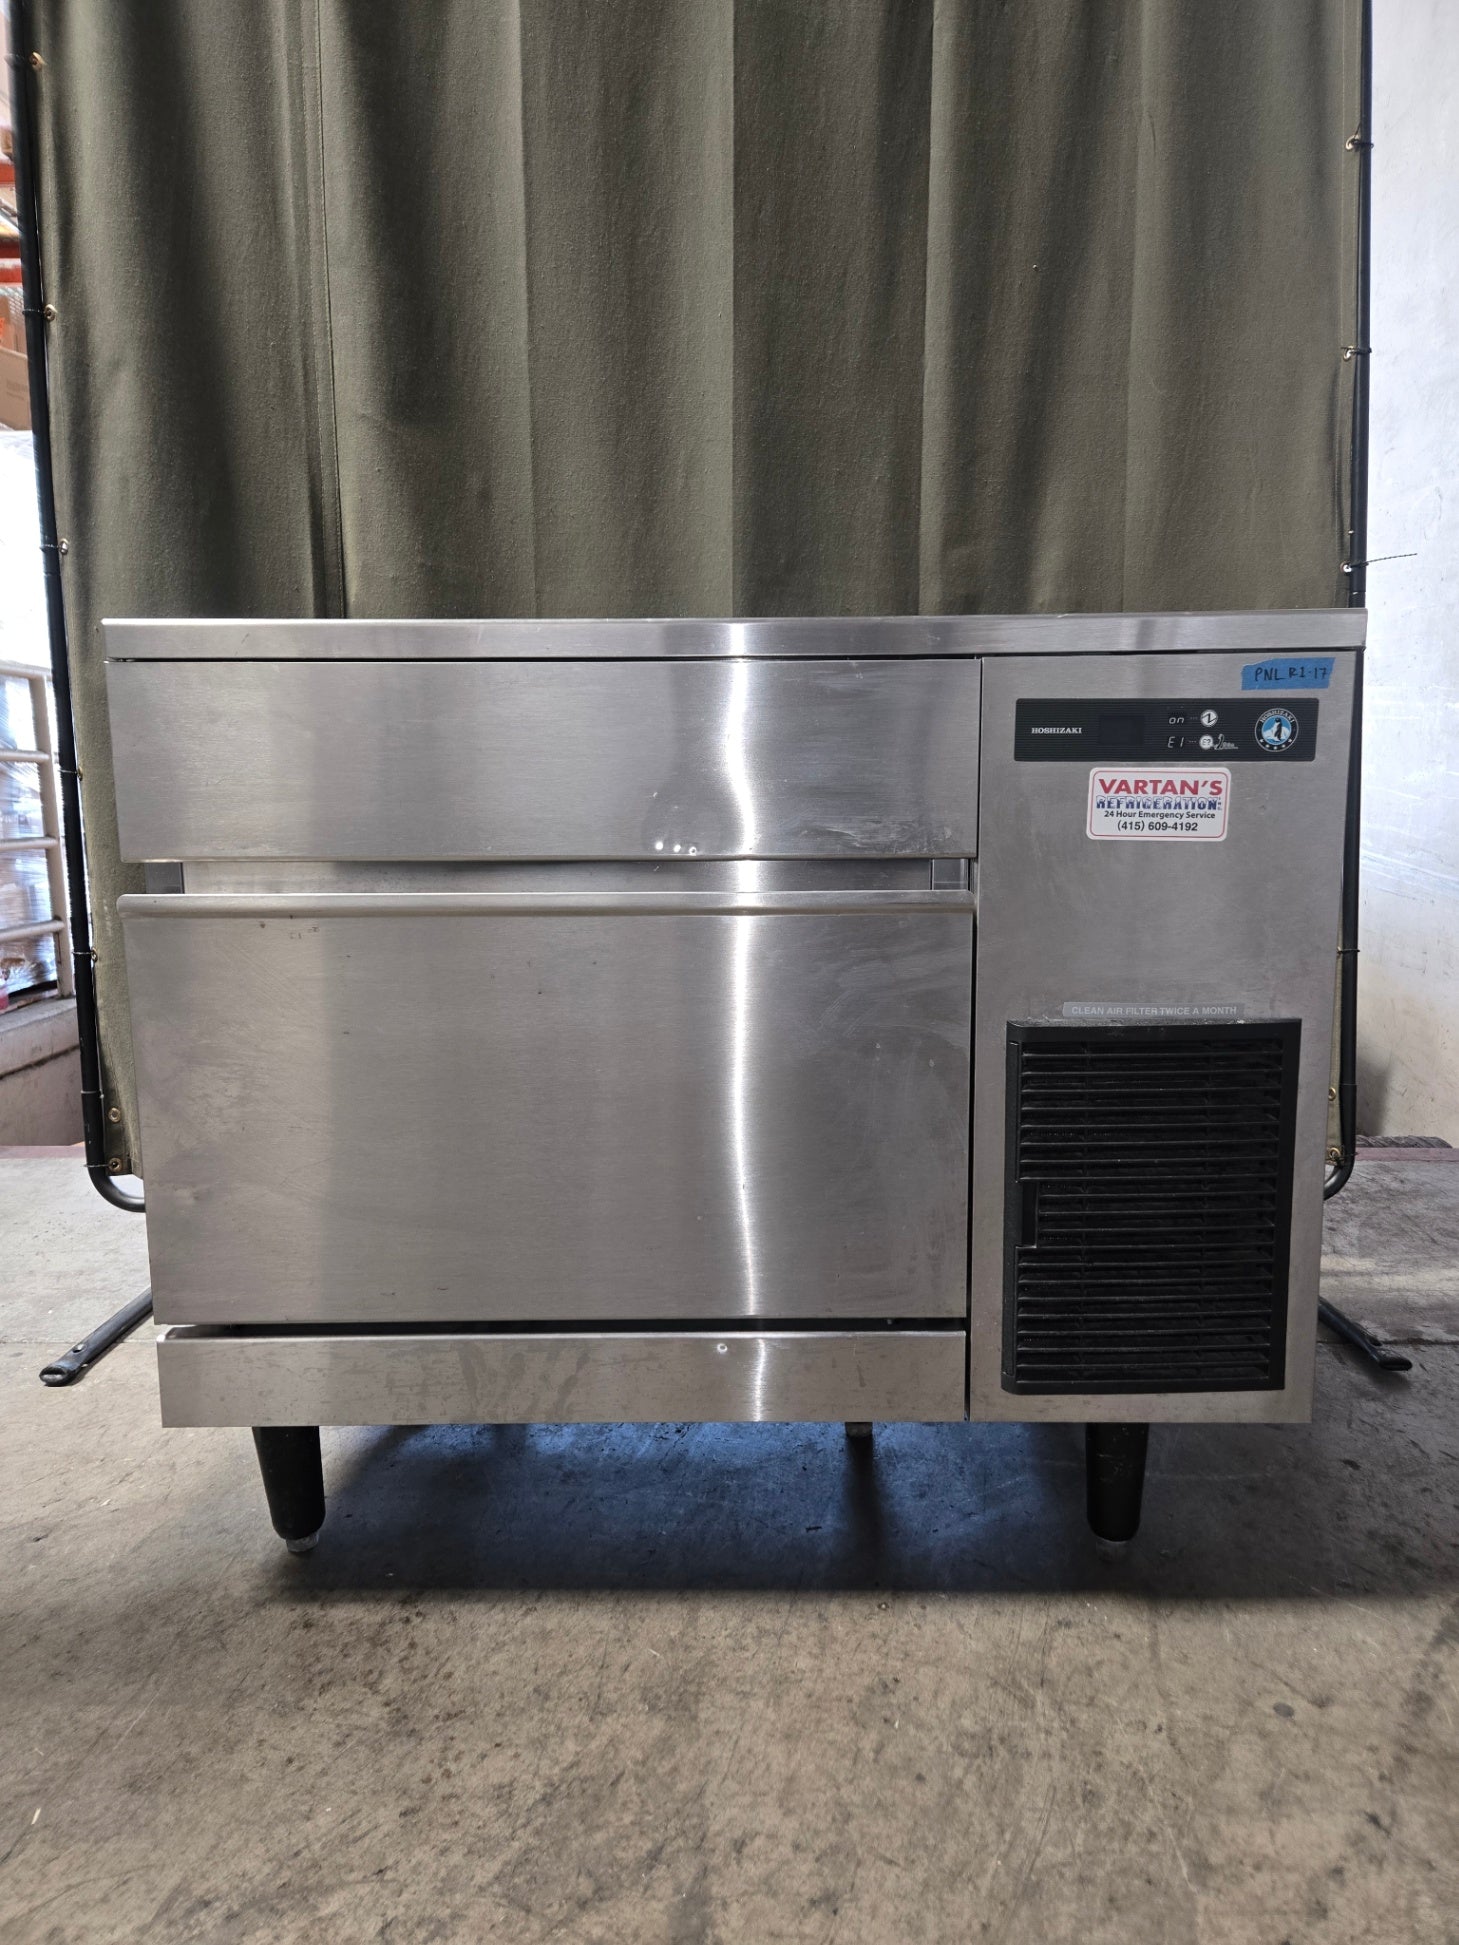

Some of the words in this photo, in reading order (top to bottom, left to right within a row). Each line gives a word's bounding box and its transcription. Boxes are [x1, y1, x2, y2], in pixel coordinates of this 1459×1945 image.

[1254, 666, 1286, 681] PNL
[1098, 778, 1223, 796] VARTAN'S
[1104, 810, 1115, 818] 24
[1138, 811, 1184, 820] Emergency
[1185, 811, 1216, 819] Service
[1117, 820, 1145, 832] (415)
[1148, 821, 1198, 832] 609-4192
[1071, 1006, 1104, 1015] CLEAN
[1107, 1007, 1123, 1015] AIR
[1125, 1007, 1158, 1016] FILTER
[1160, 1007, 1190, 1016] TWICE
[1192, 1007, 1200, 1015] A
[1202, 1006, 1237, 1015] MONTH
